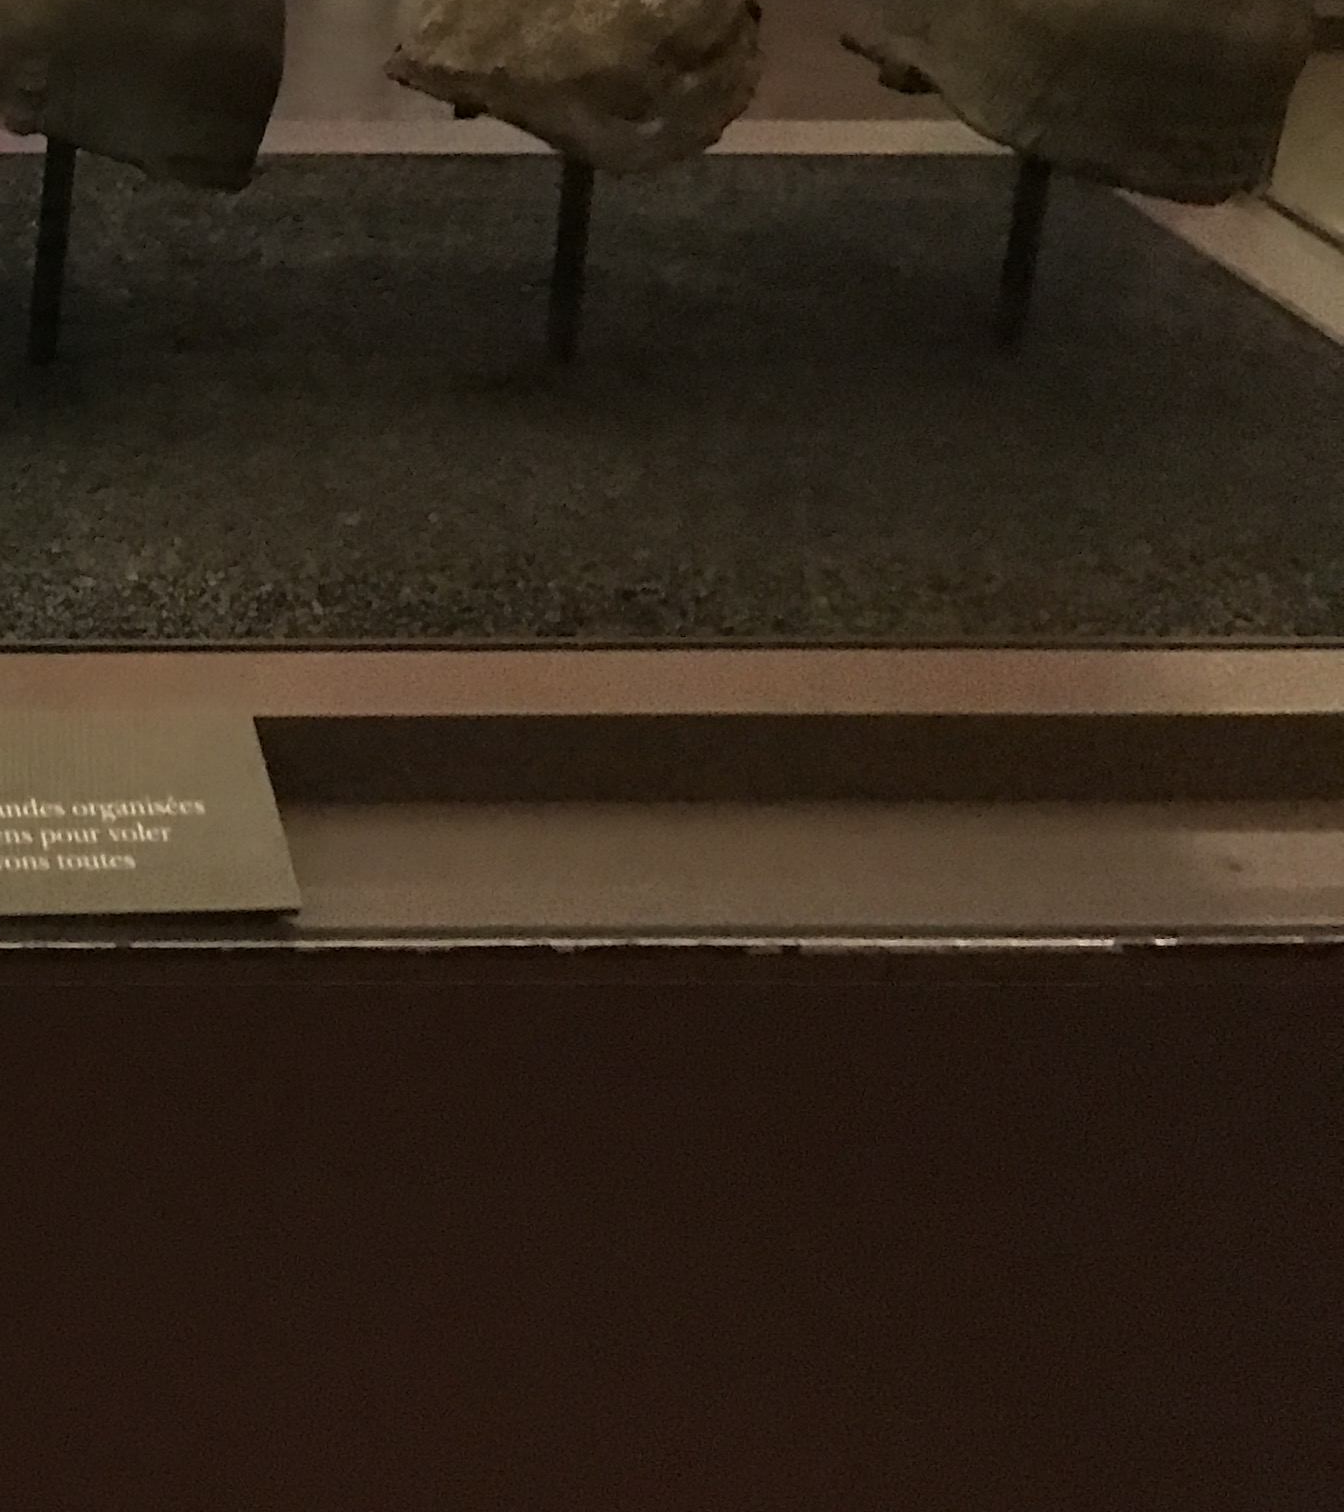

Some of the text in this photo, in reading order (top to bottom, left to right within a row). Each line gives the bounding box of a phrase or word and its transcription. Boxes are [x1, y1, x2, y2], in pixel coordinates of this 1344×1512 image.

[71, 796, 206, 823] organisées
[40, 828, 101, 851] pour
[108, 822, 172, 844] voler
[57, 853, 137, 871] toutes
